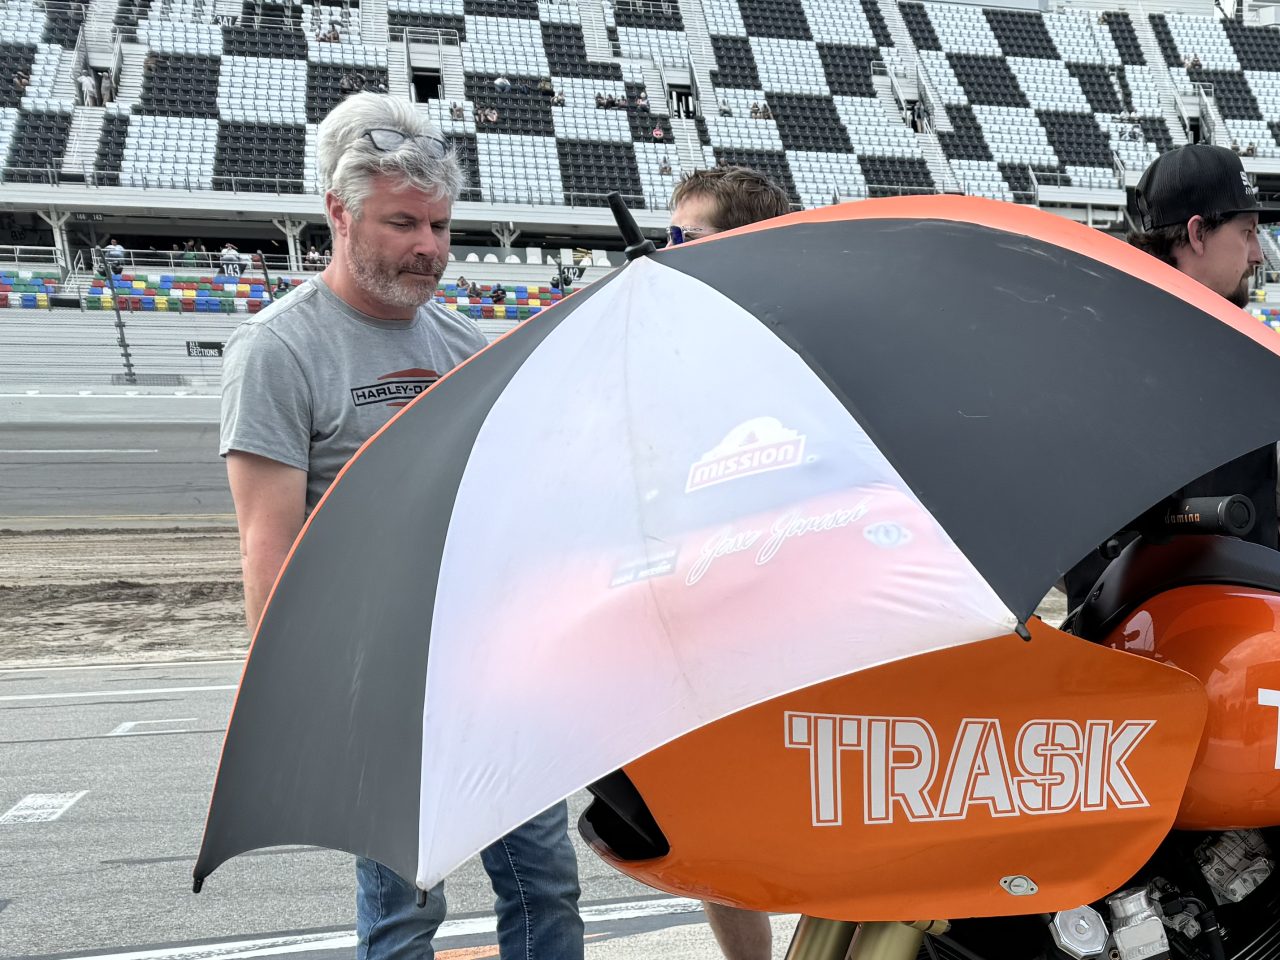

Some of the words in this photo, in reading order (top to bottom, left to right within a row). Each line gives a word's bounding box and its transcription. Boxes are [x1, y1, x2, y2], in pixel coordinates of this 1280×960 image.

[222, 263, 240, 277] 143
[189, 348, 219, 357] SECTIONS
[784, 710, 1158, 826] TRASK
